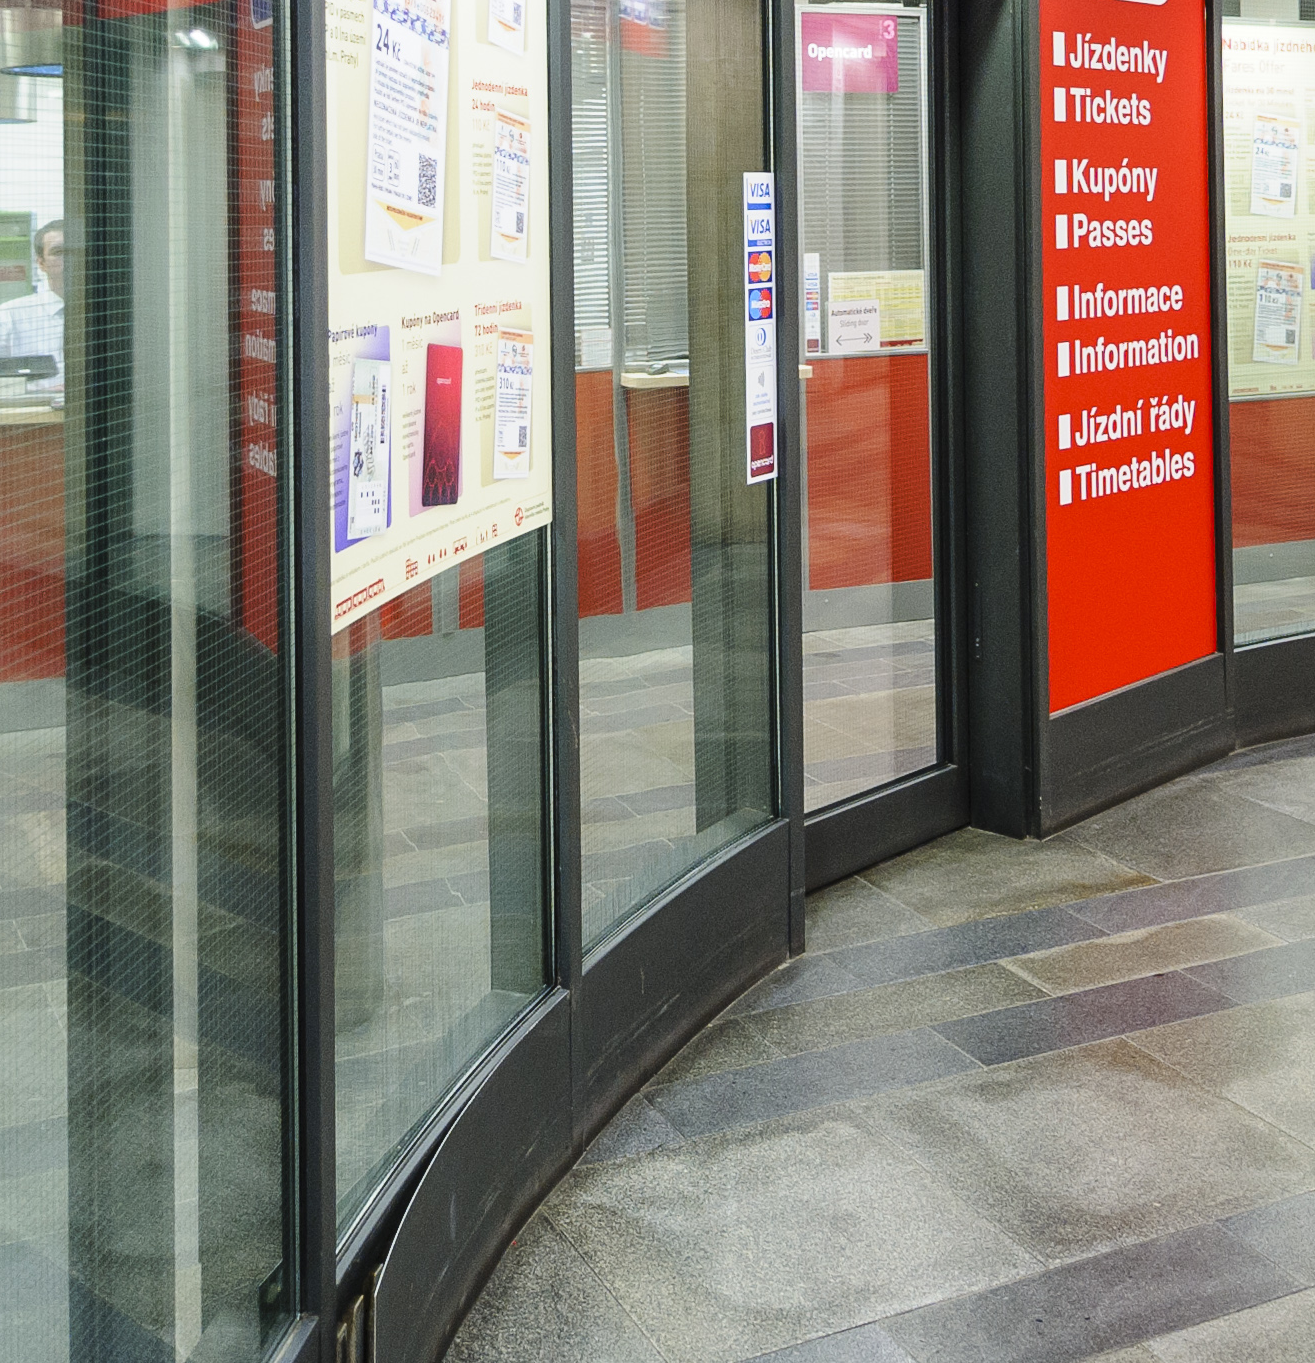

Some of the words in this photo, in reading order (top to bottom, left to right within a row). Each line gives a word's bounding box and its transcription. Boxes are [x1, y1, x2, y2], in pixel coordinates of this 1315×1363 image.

[376, 23, 390, 55] 24
[883, 20, 895, 39] 3
[807, 43, 872, 61] Opencard
[1069, 32, 1167, 83] Jízdenky
[1069, 87, 1152, 125] Tickets
[749, 182, 771, 198] VISA
[1072, 158, 1158, 202] Kupóny
[750, 218, 772, 234] VISA
[1072, 212, 1153, 248] Passes
[1073, 282, 1183, 319] Informace
[401, 313, 424, 331] Kupóny
[1074, 328, 1199, 374] Information
[1075, 399, 1144, 447] Jízdní
[1150, 394, 1196, 435] řády
[1075, 448, 1195, 501] Timetables
